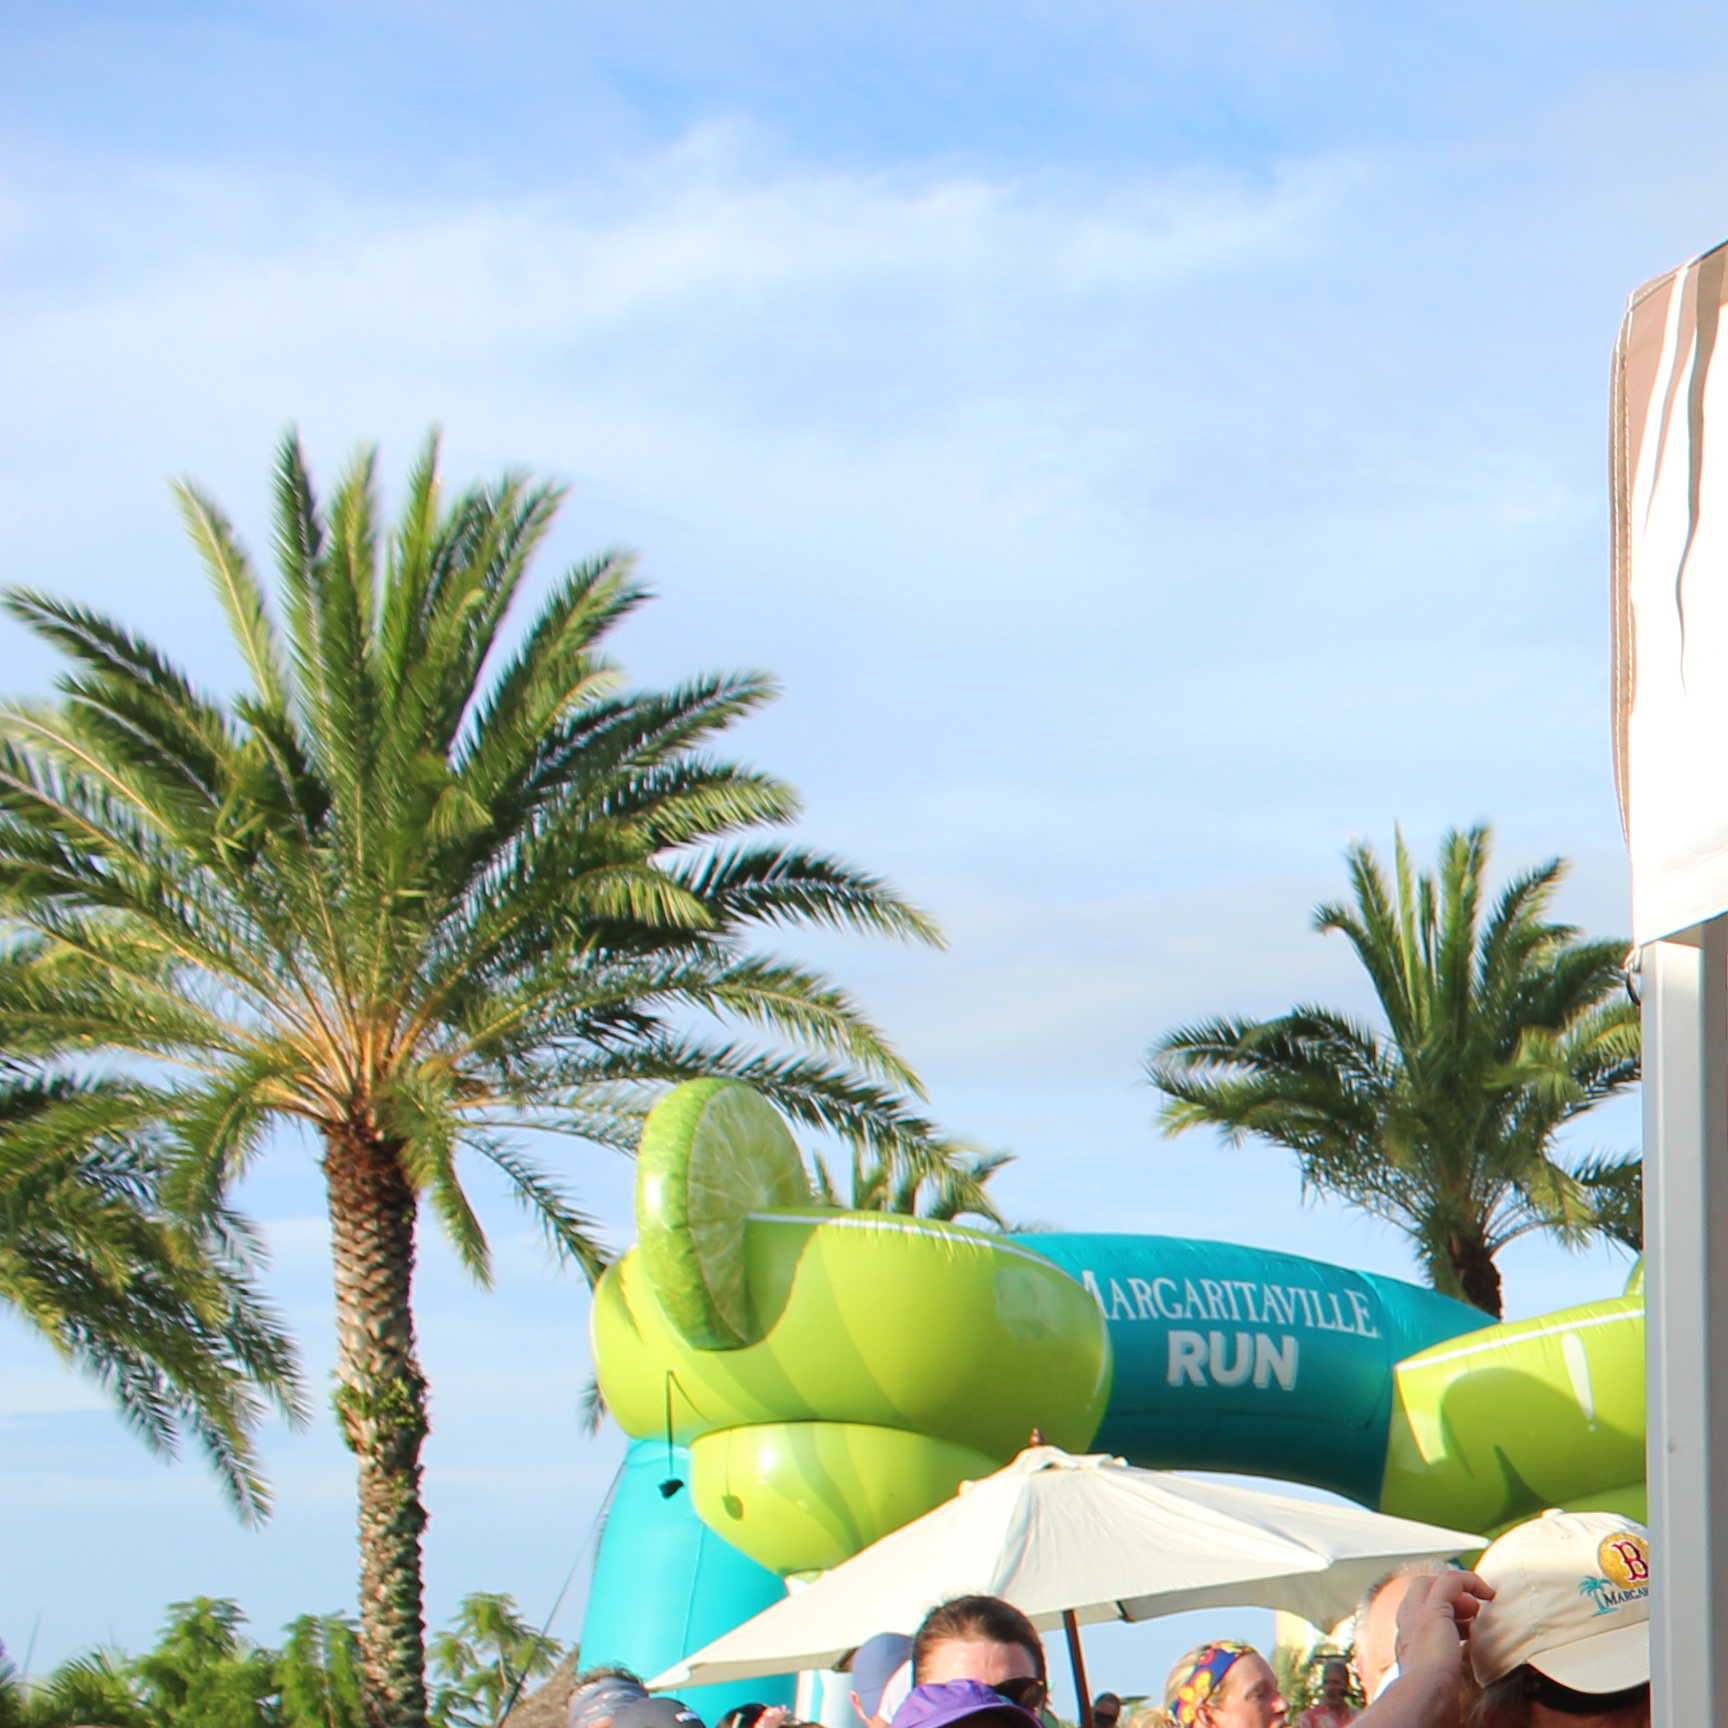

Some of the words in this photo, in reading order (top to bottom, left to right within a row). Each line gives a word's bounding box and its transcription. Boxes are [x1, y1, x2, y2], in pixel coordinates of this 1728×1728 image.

[1081, 1269, 1378, 1339] MARGARITAVILLE
[1167, 1329, 1299, 1391] RUN
[1610, 1540, 1649, 1581] B
